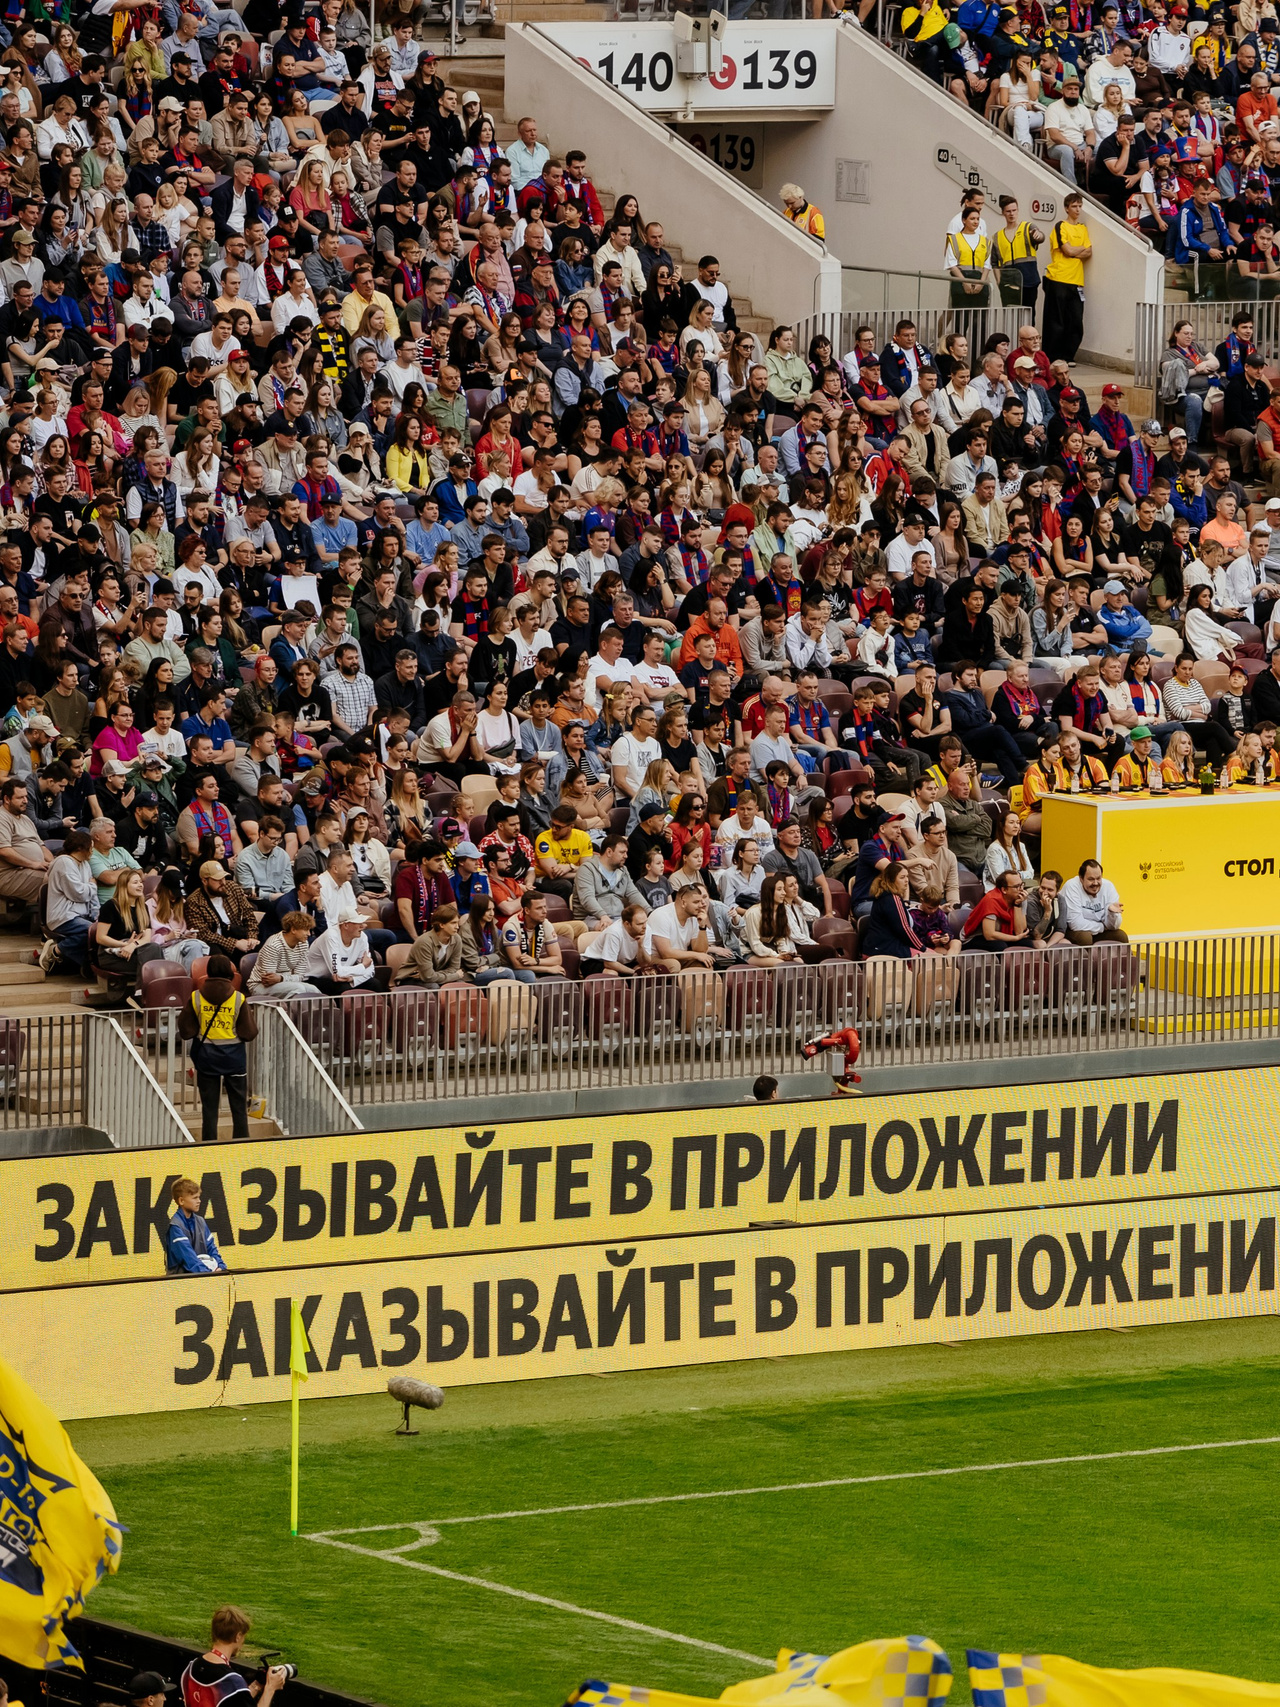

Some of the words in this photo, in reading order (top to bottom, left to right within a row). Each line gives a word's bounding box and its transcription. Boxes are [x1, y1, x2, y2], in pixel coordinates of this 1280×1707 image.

[598, 51, 674, 92] 140
[743, 50, 817, 90] 139
[938, 152, 949, 162] 40
[969, 174, 978, 184] 18
[1041, 202, 1055, 213] 139
[1154, 860, 1184, 868] РОССИЙСКИЙ
[1223, 857, 1275, 878] стол
[34, 1130, 594, 1262] ЗАКАЗЫВАЙТЕ
[609, 1139, 653, 1215] В
[669, 1099, 1180, 1212] ПРИЛОЖЕНИИ
[173, 1248, 737, 1385] ЗАКАЗЫВАЙТЕ
[754, 1255, 798, 1333] В
